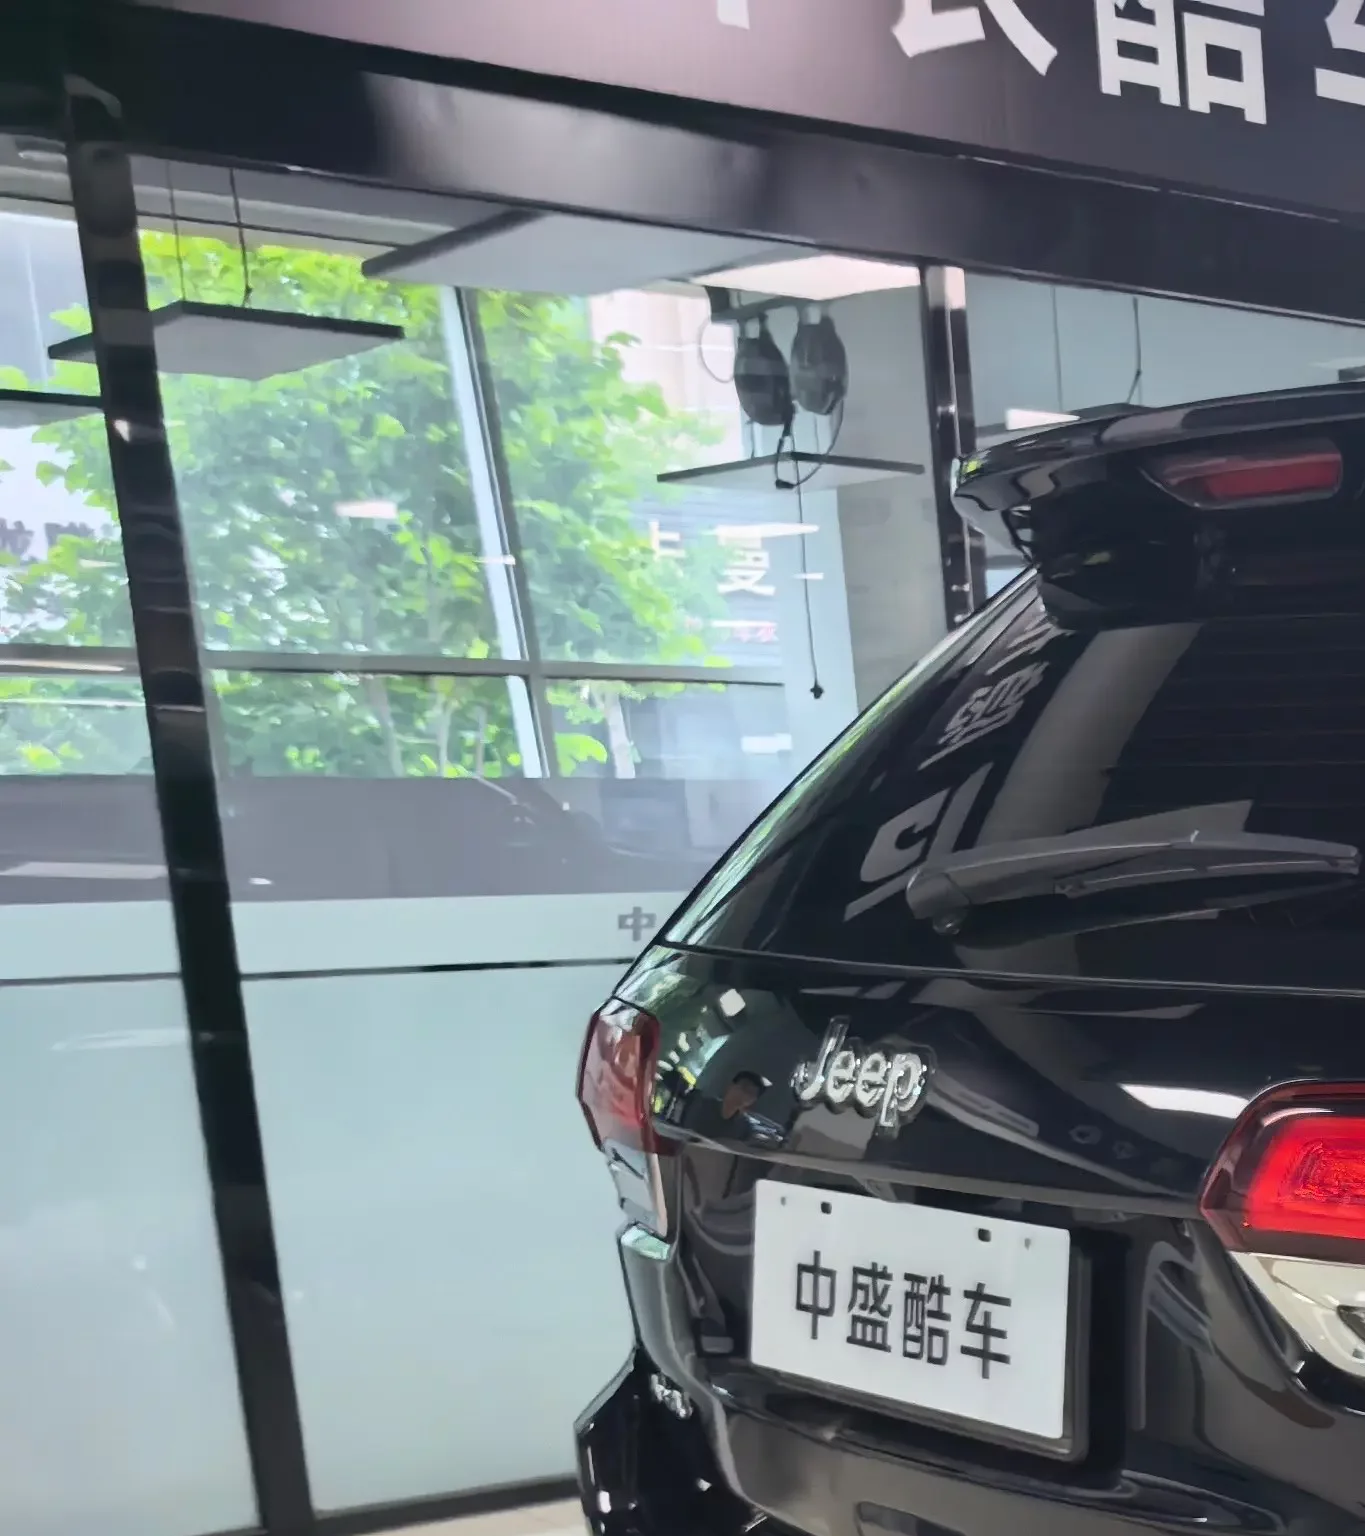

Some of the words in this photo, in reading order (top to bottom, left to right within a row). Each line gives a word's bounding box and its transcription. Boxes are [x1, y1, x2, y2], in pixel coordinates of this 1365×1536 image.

[790, 1016, 928, 1128] Jeep
[795, 1250, 1012, 1380] 中盛酷车
